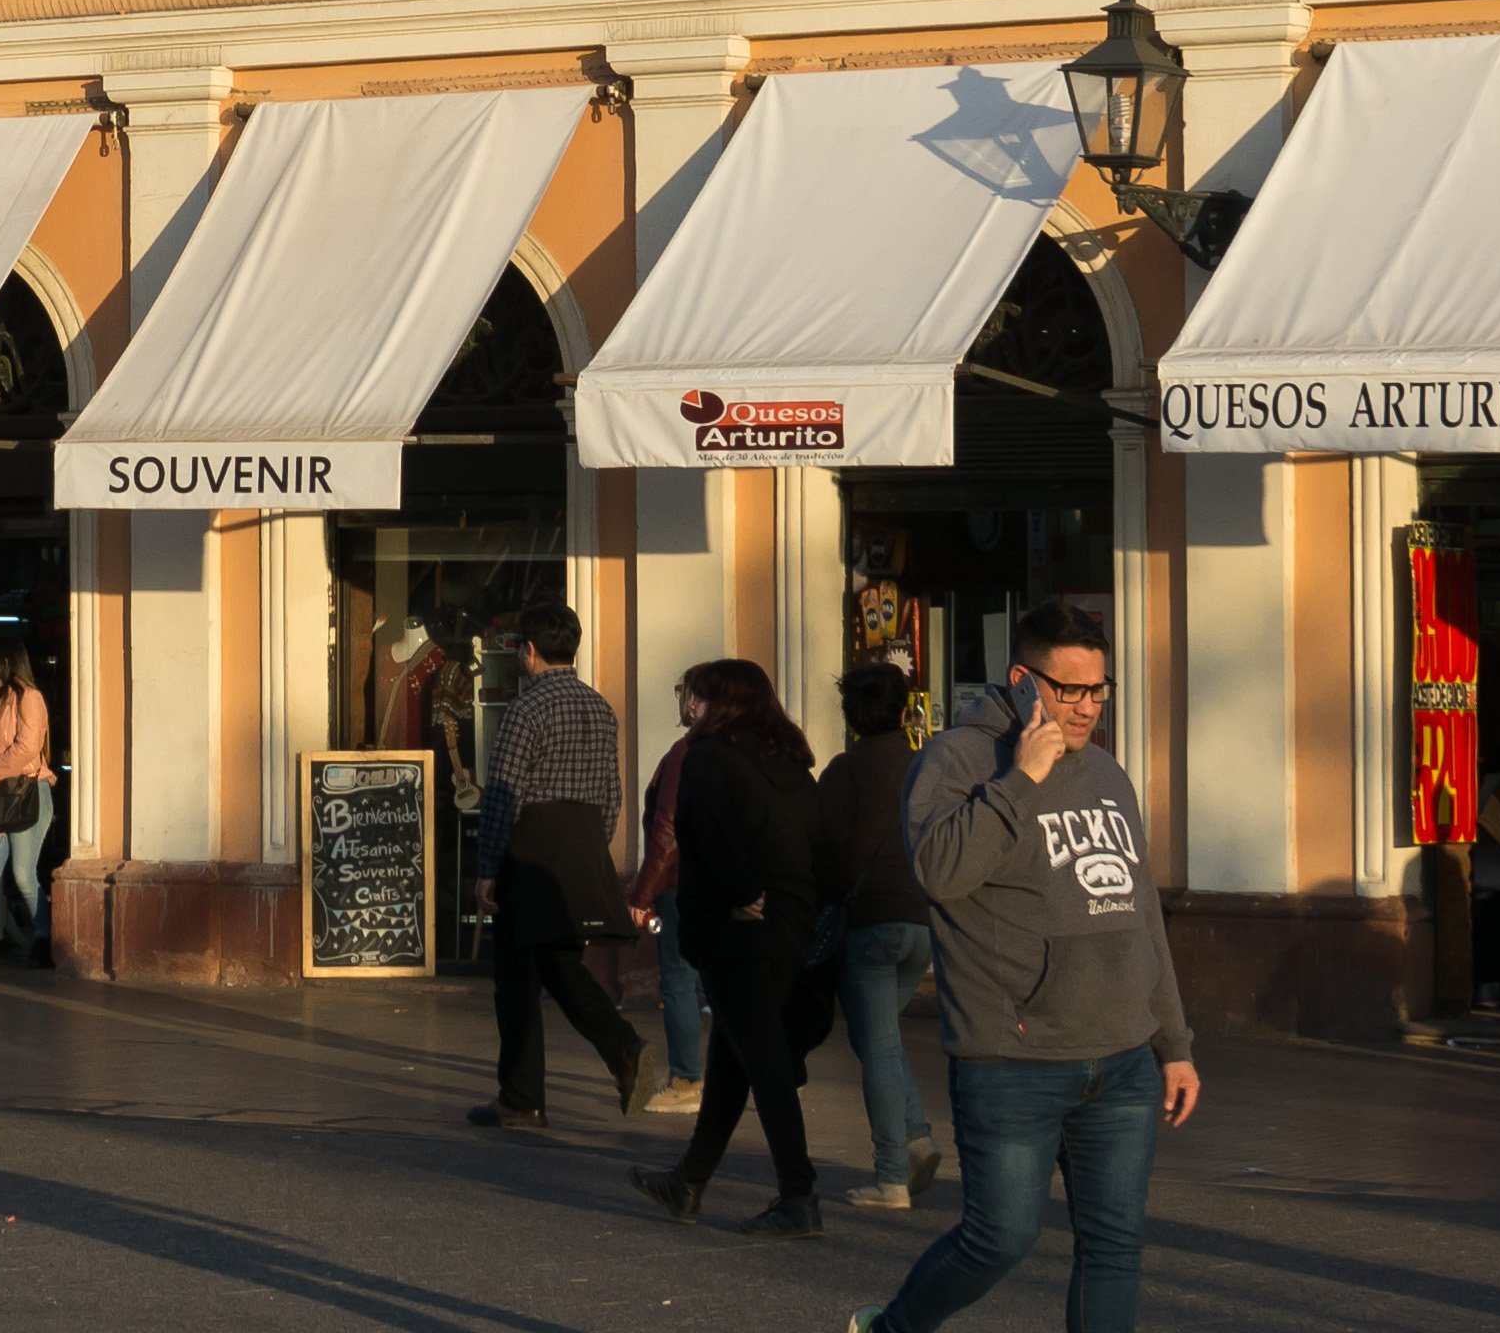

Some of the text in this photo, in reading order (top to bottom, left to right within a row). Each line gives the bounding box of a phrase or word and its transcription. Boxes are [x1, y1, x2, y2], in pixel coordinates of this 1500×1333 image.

[730, 403, 842, 426] Quesos
[1161, 382, 1328, 441] QUESOS
[701, 426, 838, 448] Arturito
[722, 453, 735, 462] de
[780, 452, 793, 461] de
[108, 456, 332, 494] SOUVENIR
[338, 864, 415, 883] Souvenirs
